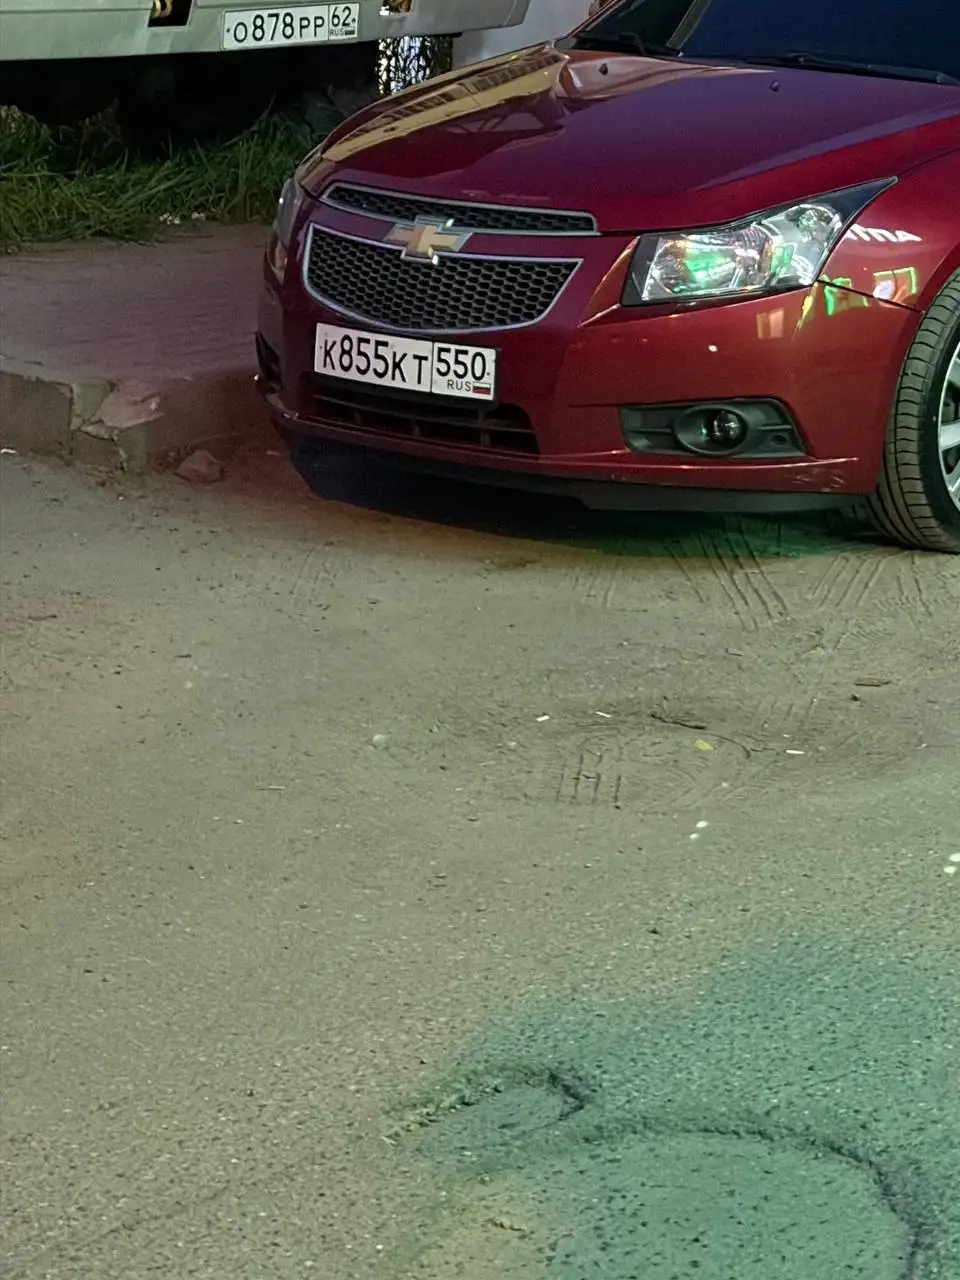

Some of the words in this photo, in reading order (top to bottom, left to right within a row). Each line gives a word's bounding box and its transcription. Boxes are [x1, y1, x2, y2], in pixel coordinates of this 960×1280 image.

[331, 6, 352, 27] 62
[329, 28, 344, 36] RUS
[436, 346, 487, 381] 550
[446, 379, 472, 392] RUS
